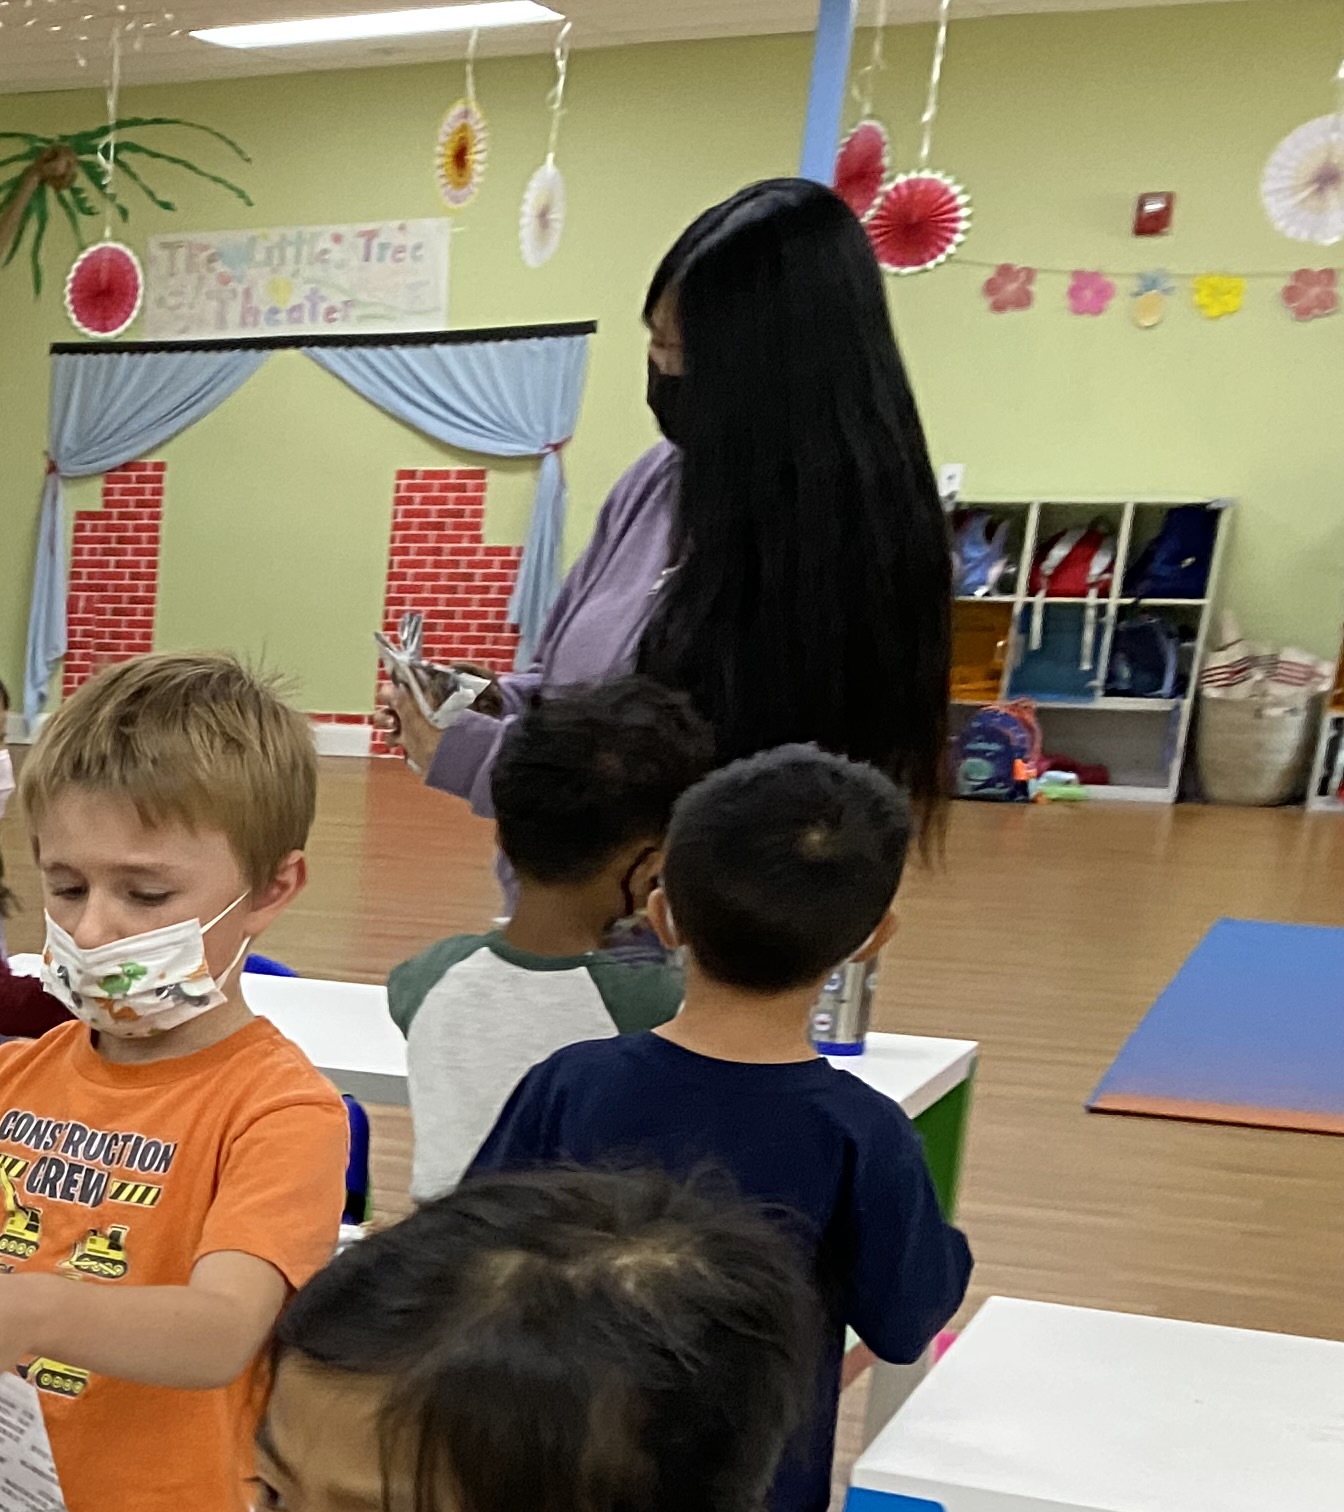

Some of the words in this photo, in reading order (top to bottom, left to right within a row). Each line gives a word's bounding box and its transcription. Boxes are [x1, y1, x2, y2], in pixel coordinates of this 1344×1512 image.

[159, 240, 220, 277] The
[355, 228, 425, 263] Tree
[206, 286, 354, 330] Theater
[25, 1155, 112, 1208] CREW
